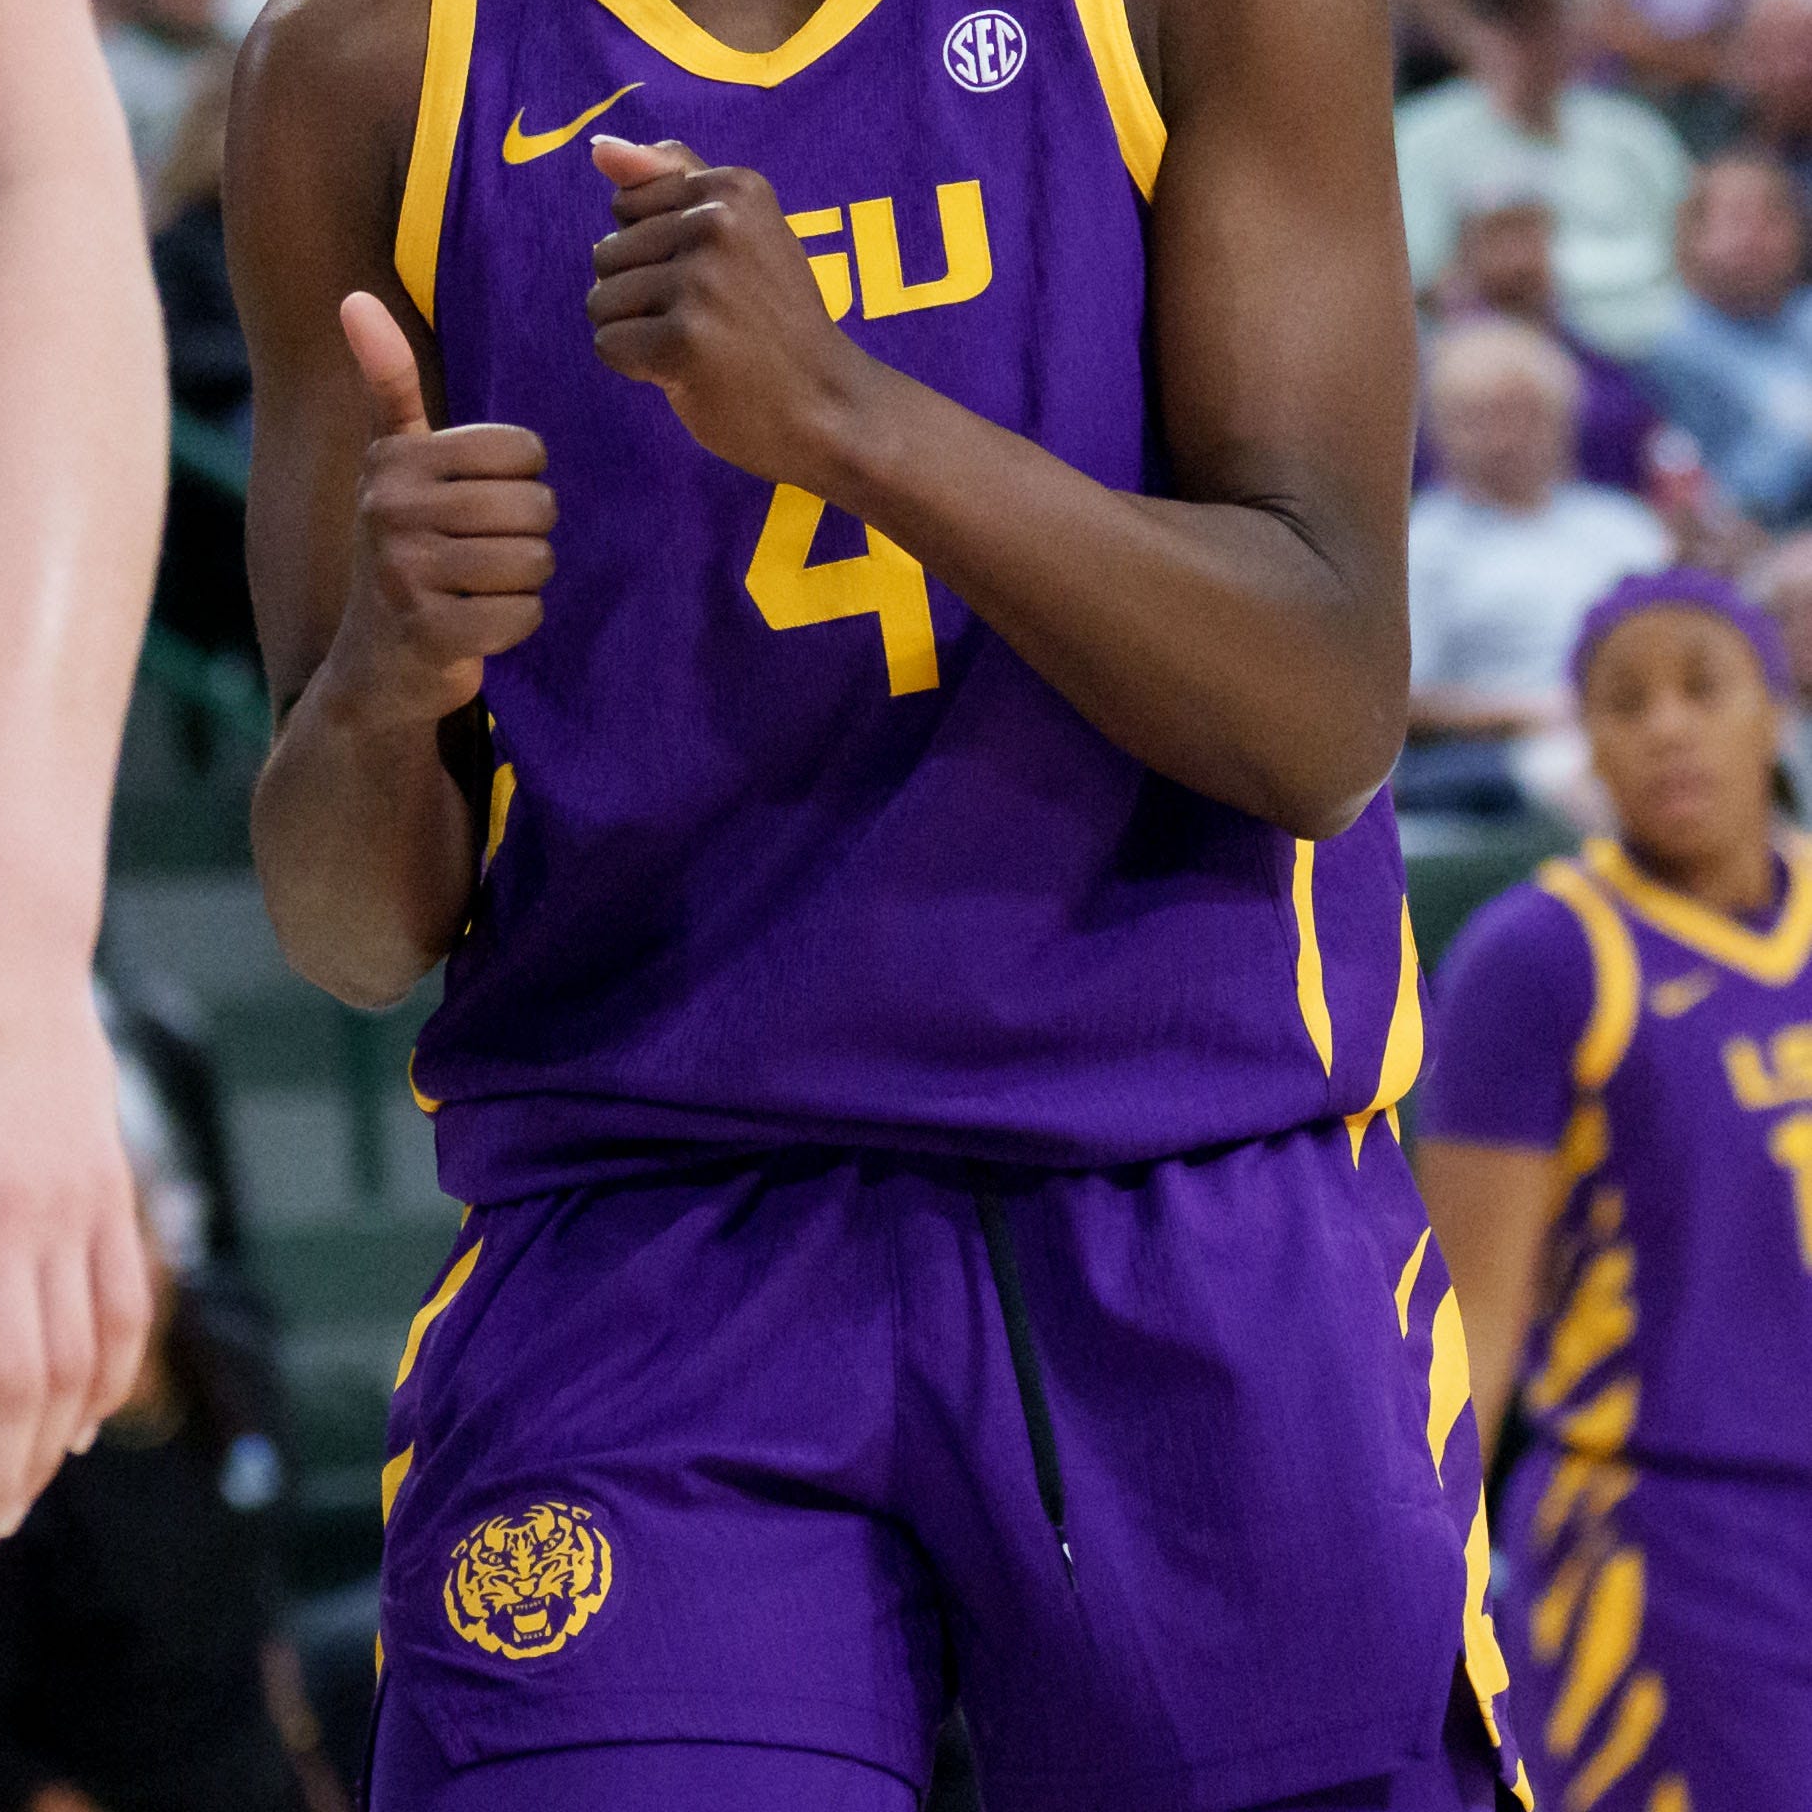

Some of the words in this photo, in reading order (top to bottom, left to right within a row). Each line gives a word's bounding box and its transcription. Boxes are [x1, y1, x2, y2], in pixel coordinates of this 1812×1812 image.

[951, 17, 1019, 85] SEC
[784, 179, 993, 323] SU
[744, 483, 940, 697] 4
